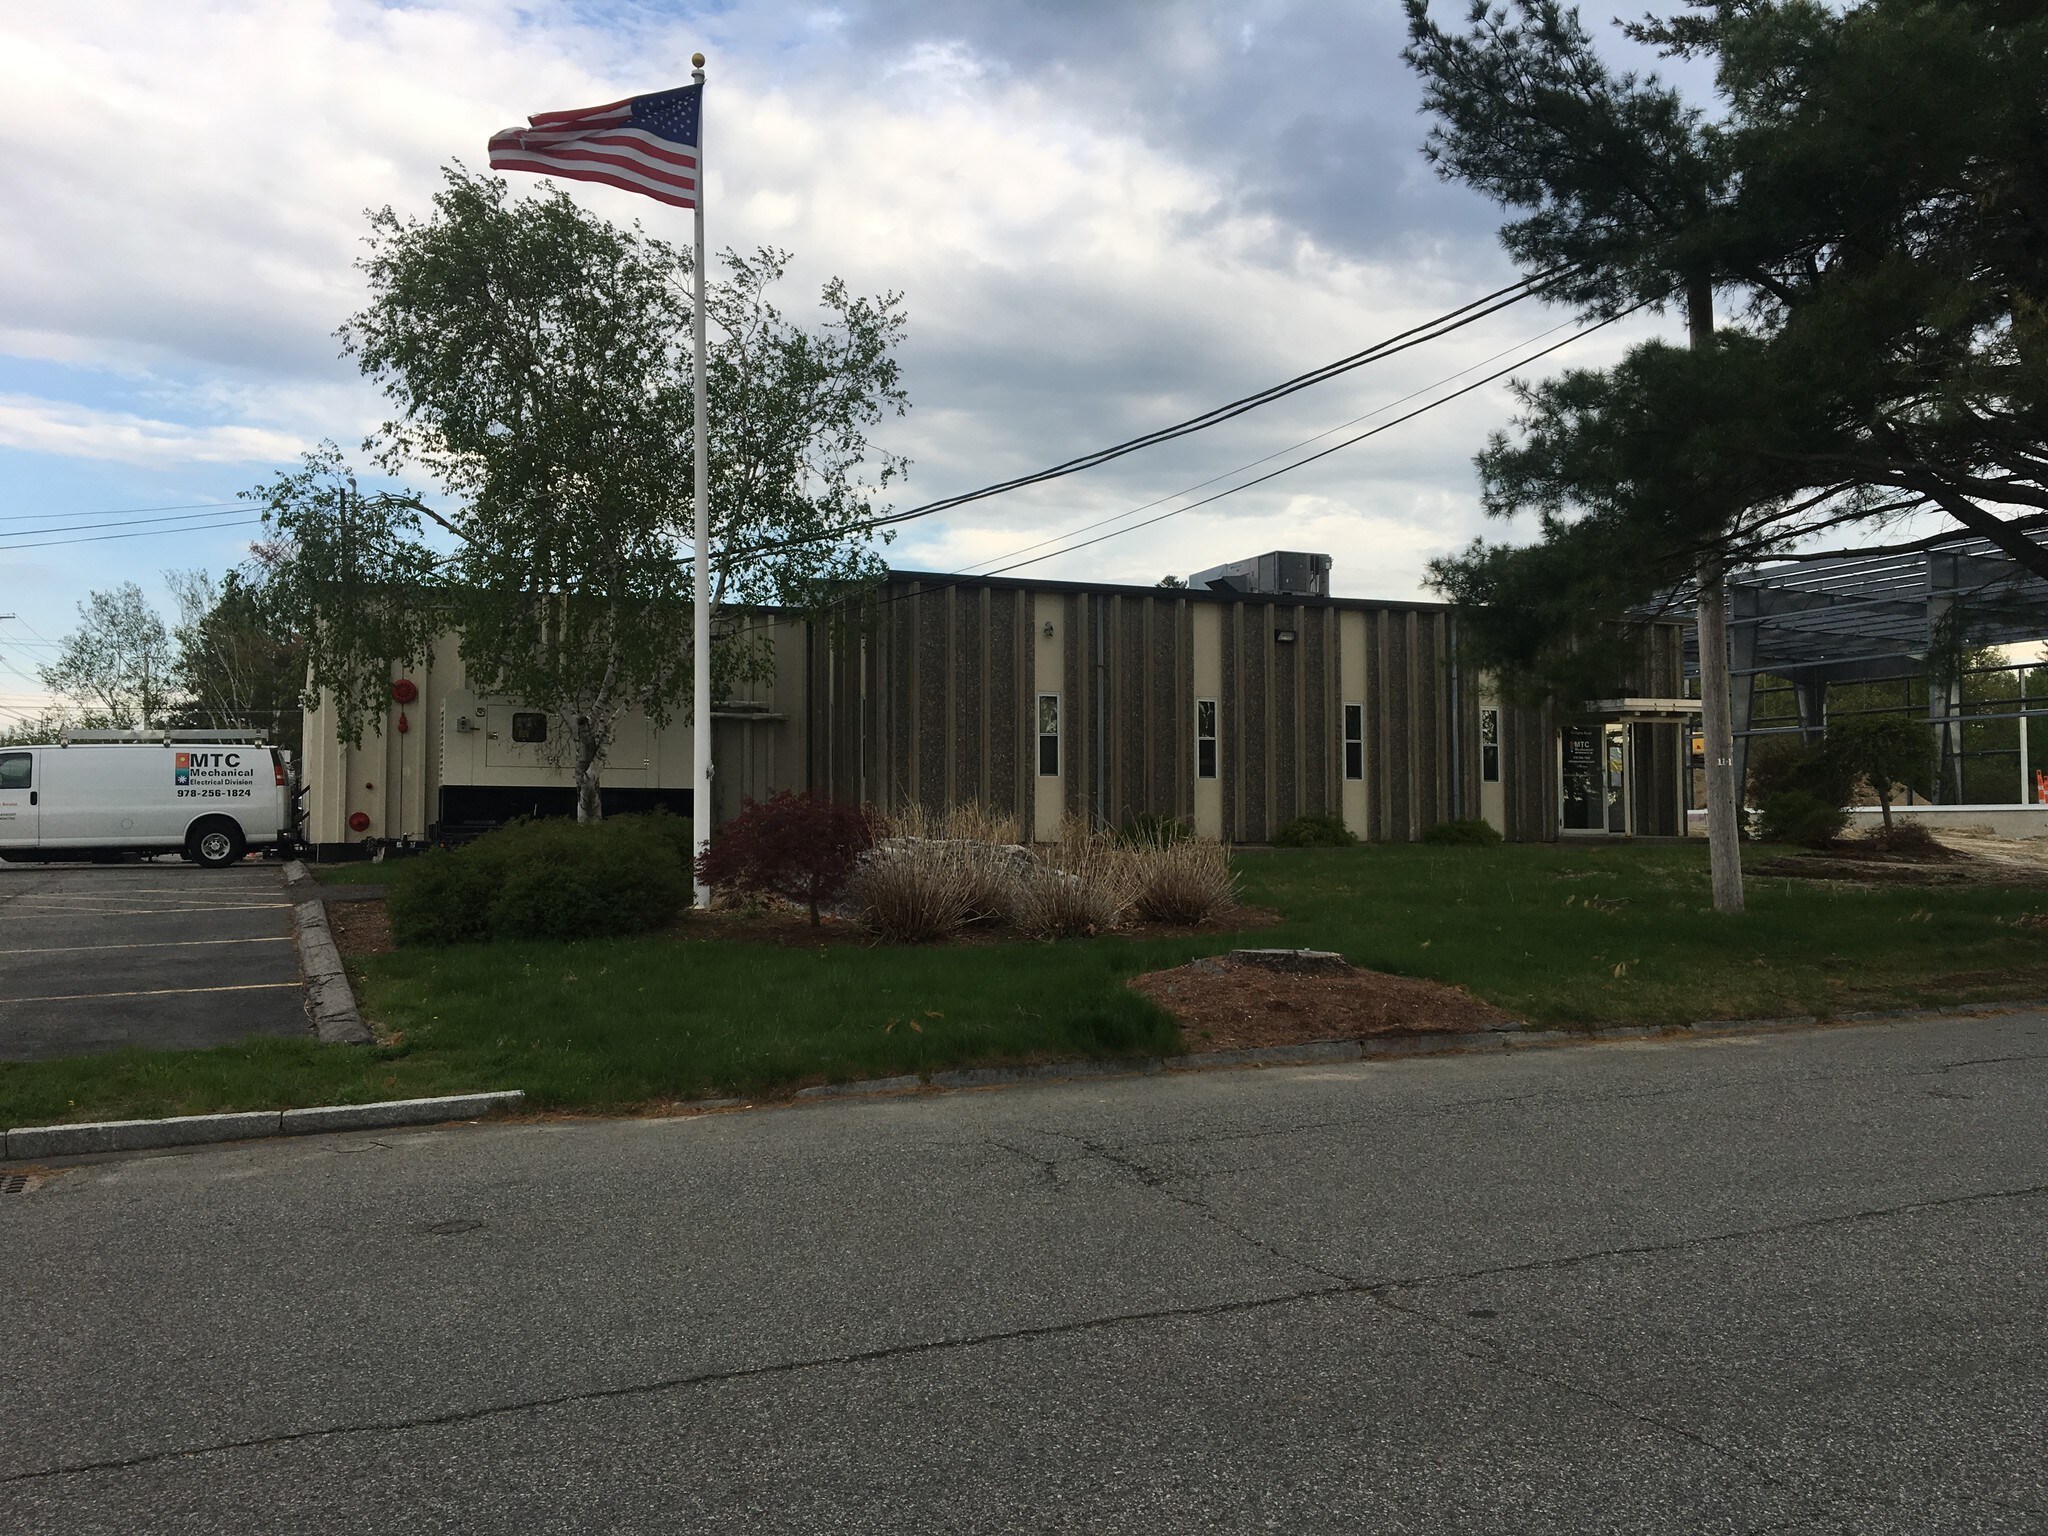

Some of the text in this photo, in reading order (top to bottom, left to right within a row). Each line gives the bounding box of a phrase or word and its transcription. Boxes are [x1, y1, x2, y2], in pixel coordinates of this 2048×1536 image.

[190, 753, 240, 768] MTC
[190, 768, 254, 777] Mechanical
[190, 778, 253, 786] Electrical Division
[177, 789, 251, 798] 978-256-1824
